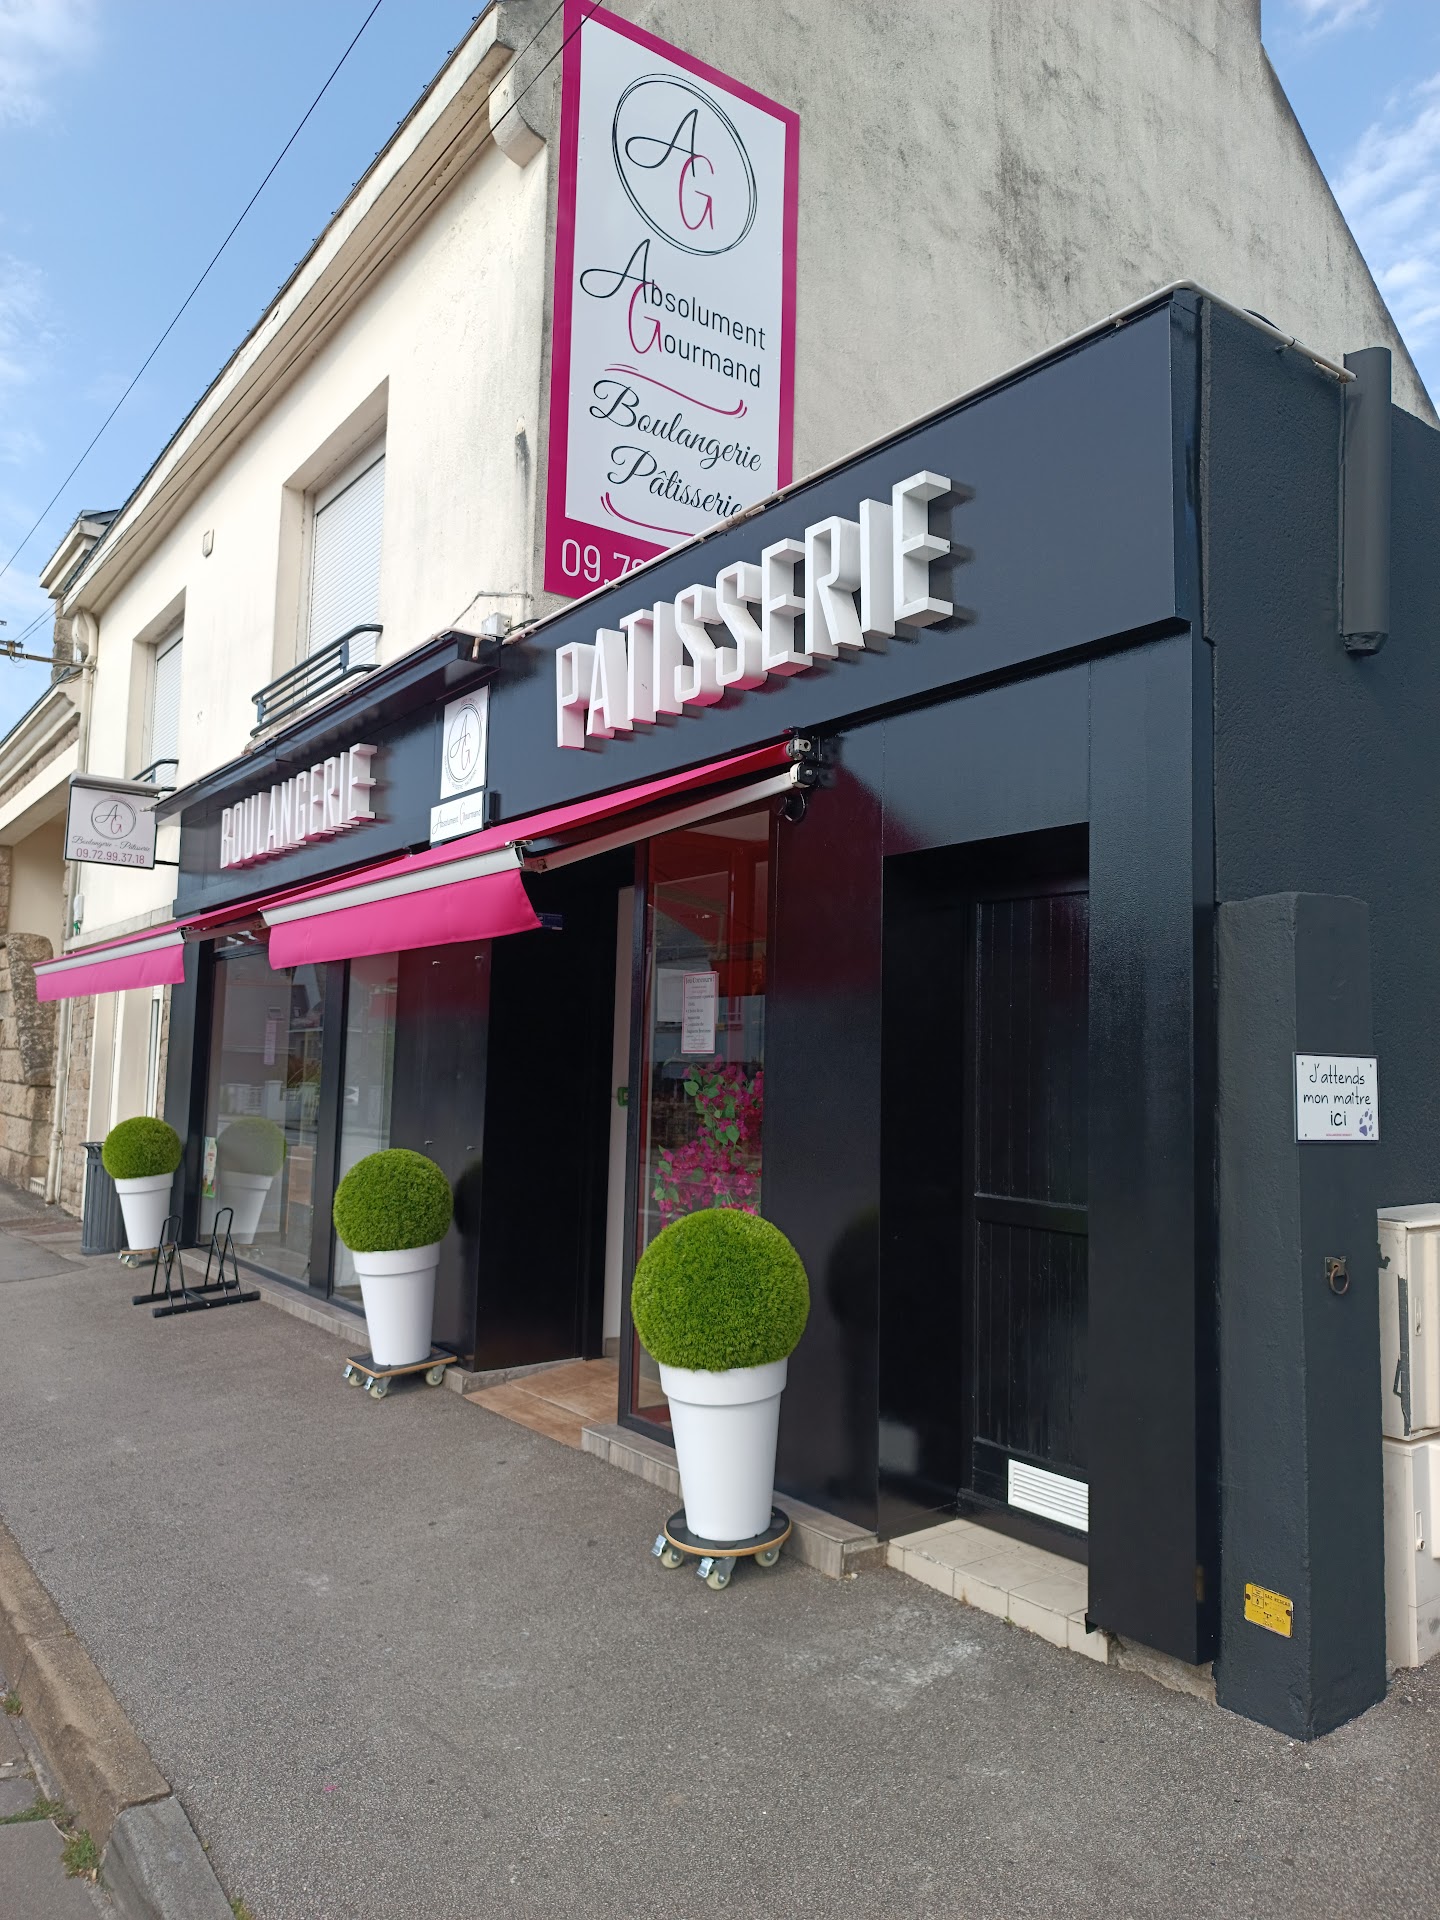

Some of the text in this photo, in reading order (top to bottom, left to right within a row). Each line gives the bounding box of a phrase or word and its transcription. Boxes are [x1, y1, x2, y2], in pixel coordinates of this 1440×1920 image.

[580, 239, 766, 351] Absolument
[628, 282, 761, 388] Gourmand
[589, 379, 762, 472] Boulangerie
[607, 445, 743, 518] Pâtisserie
[556, 470, 954, 749] PATISSERIE
[71, 835, 112, 849] Boulangerie
[220, 743, 378, 869] BOULANGERIE
[76, 848, 145, 864] 09.72.99.37.18
[1303, 1086, 1372, 1105] mon maître
[1309, 1063, 1366, 1085] J'attends
[1329, 1110, 1347, 1126] ici
